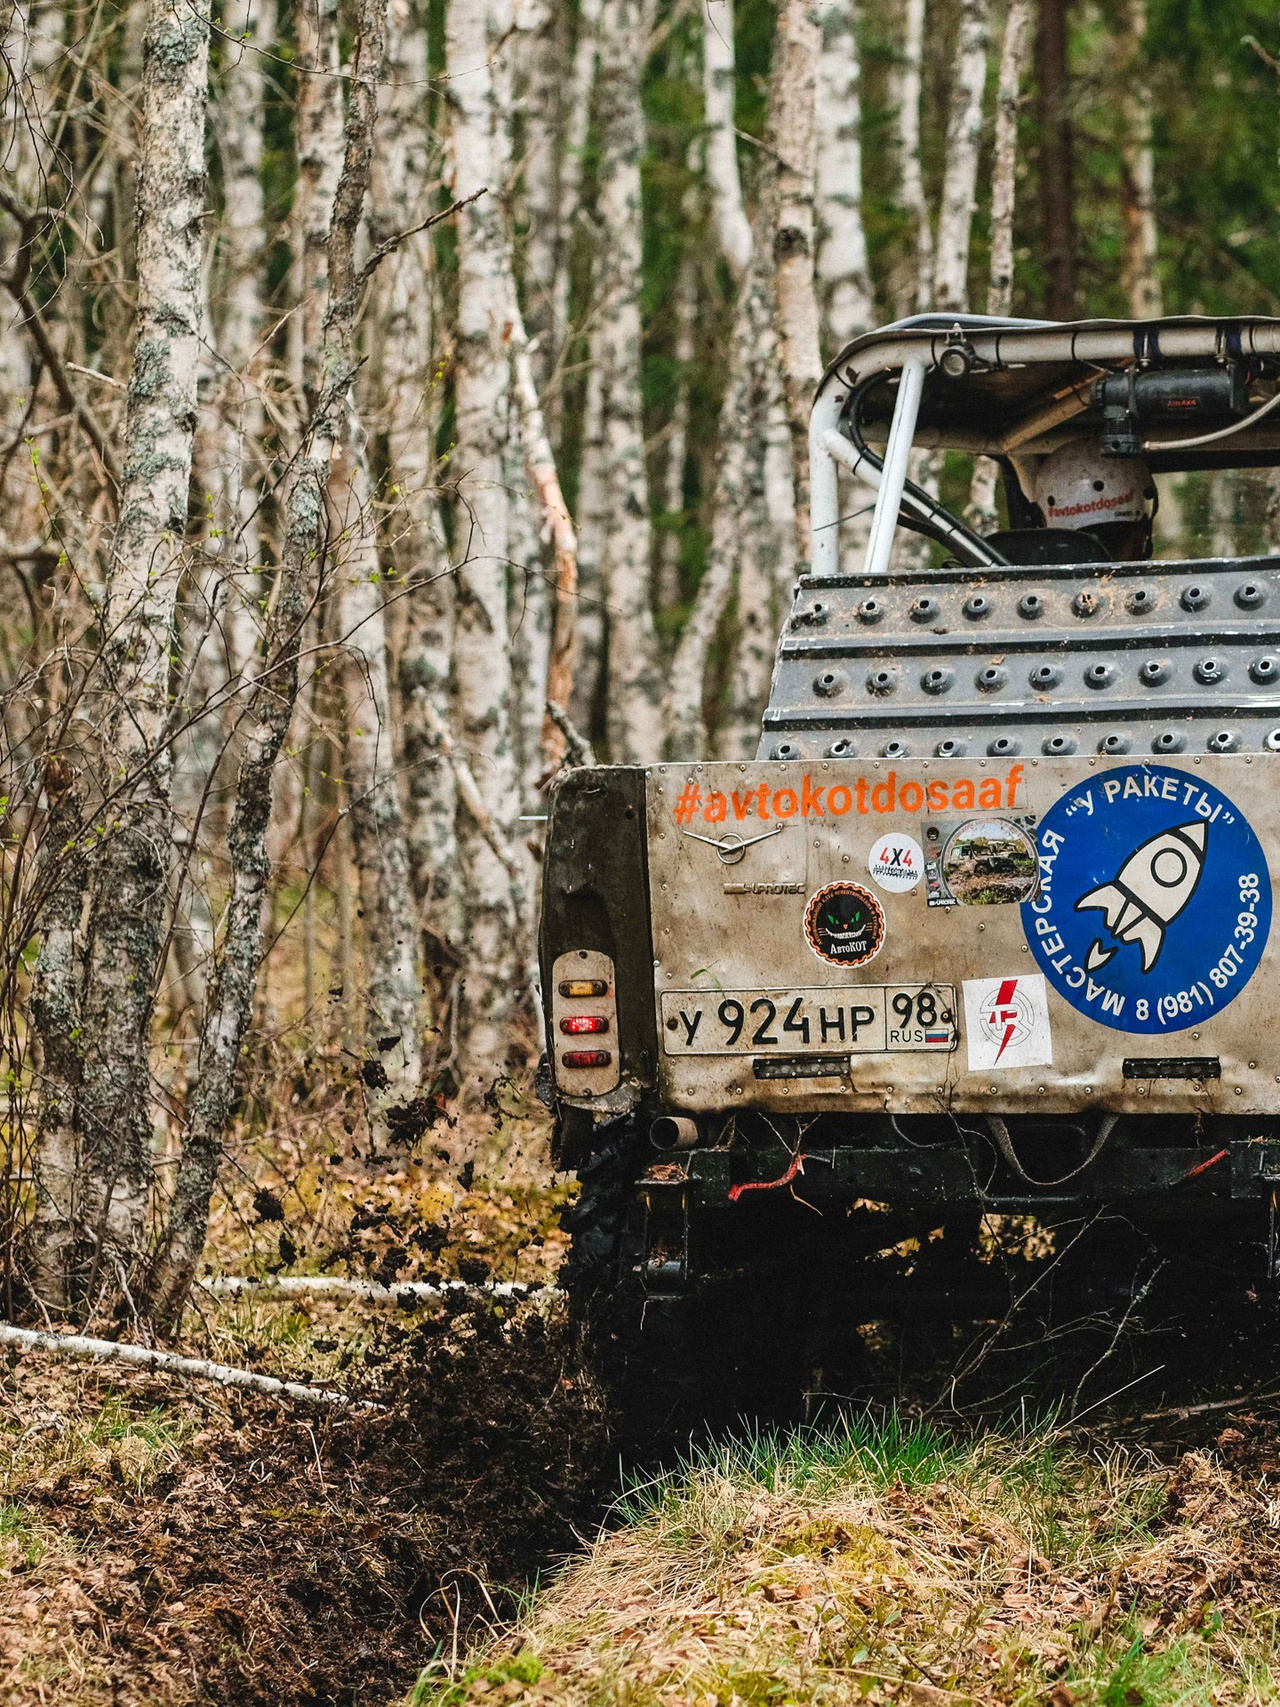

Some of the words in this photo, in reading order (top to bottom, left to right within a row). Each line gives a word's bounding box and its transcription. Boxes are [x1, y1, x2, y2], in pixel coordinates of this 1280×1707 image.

[673, 764, 1024, 824] #avtokotdosaaf
[1136, 999, 1149, 1020] 8
[1157, 981, 1214, 1025] (981)
[1209, 873, 1260, 988] 807-39-38
[892, 993, 937, 1028] 98
[890, 1029, 923, 1042] RUS
